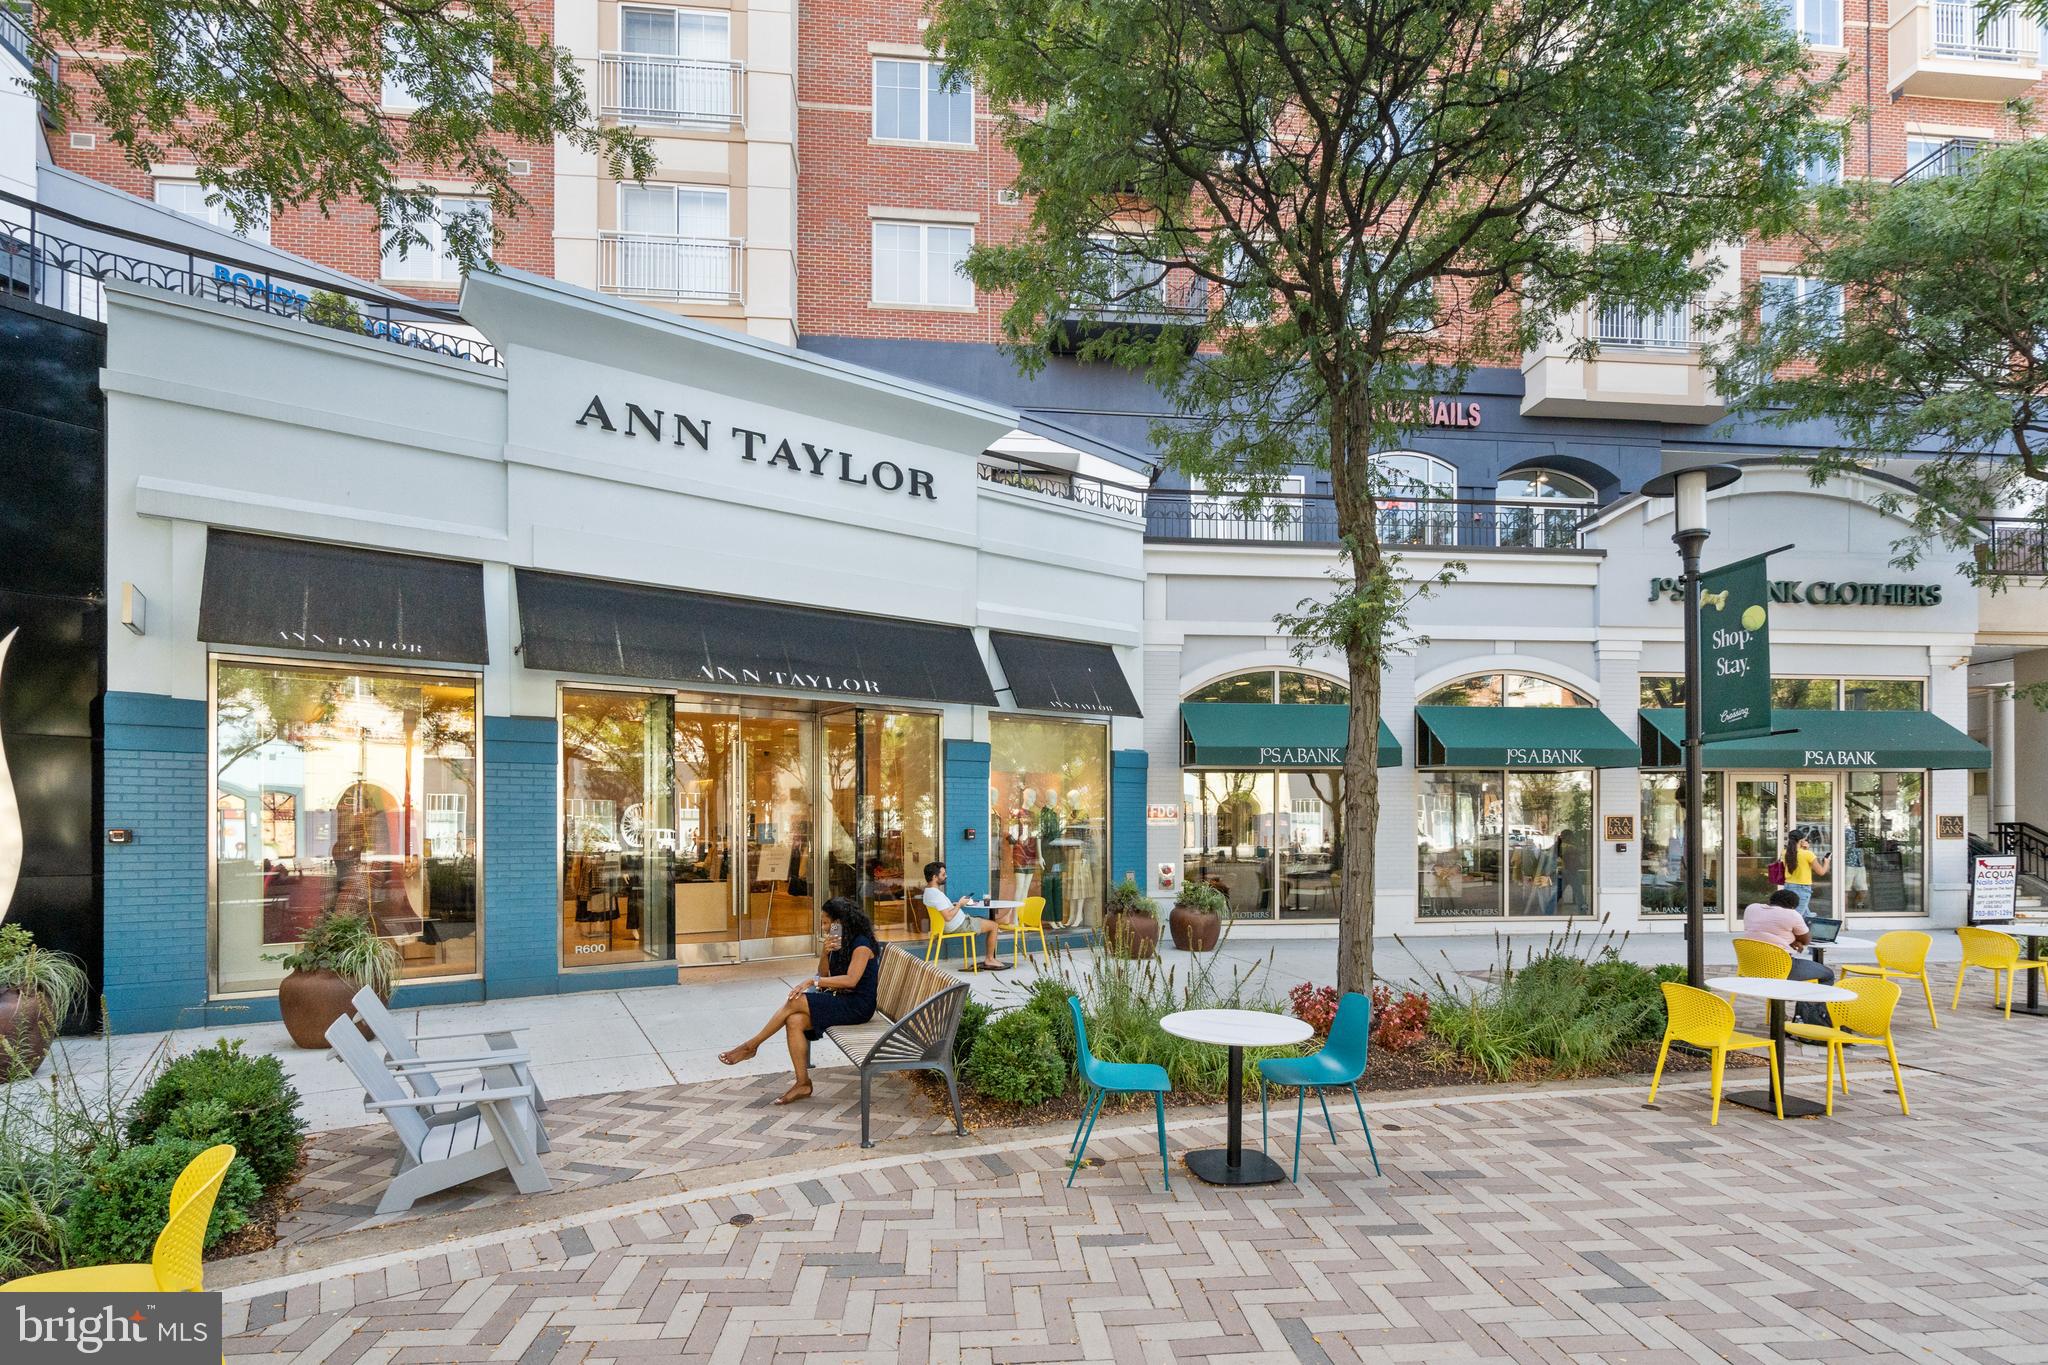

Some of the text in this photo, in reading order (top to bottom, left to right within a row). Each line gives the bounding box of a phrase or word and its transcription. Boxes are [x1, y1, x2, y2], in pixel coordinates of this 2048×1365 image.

[1419, 396, 1481, 426] NAILS
[575, 394, 938, 500] ANN TAYLOR
[1806, 581, 1943, 607] CLOTHIERS
[279, 631, 423, 653] ANN TAYLOR
[1712, 628, 1754, 650] Shop.
[698, 664, 881, 693] ANN TAYLOR
[1716, 657, 1751, 678] Stay.
[1838, 750, 1877, 765] BANK
[1977, 870, 2014, 880] ACQUA
[575, 943, 606, 954] R600
